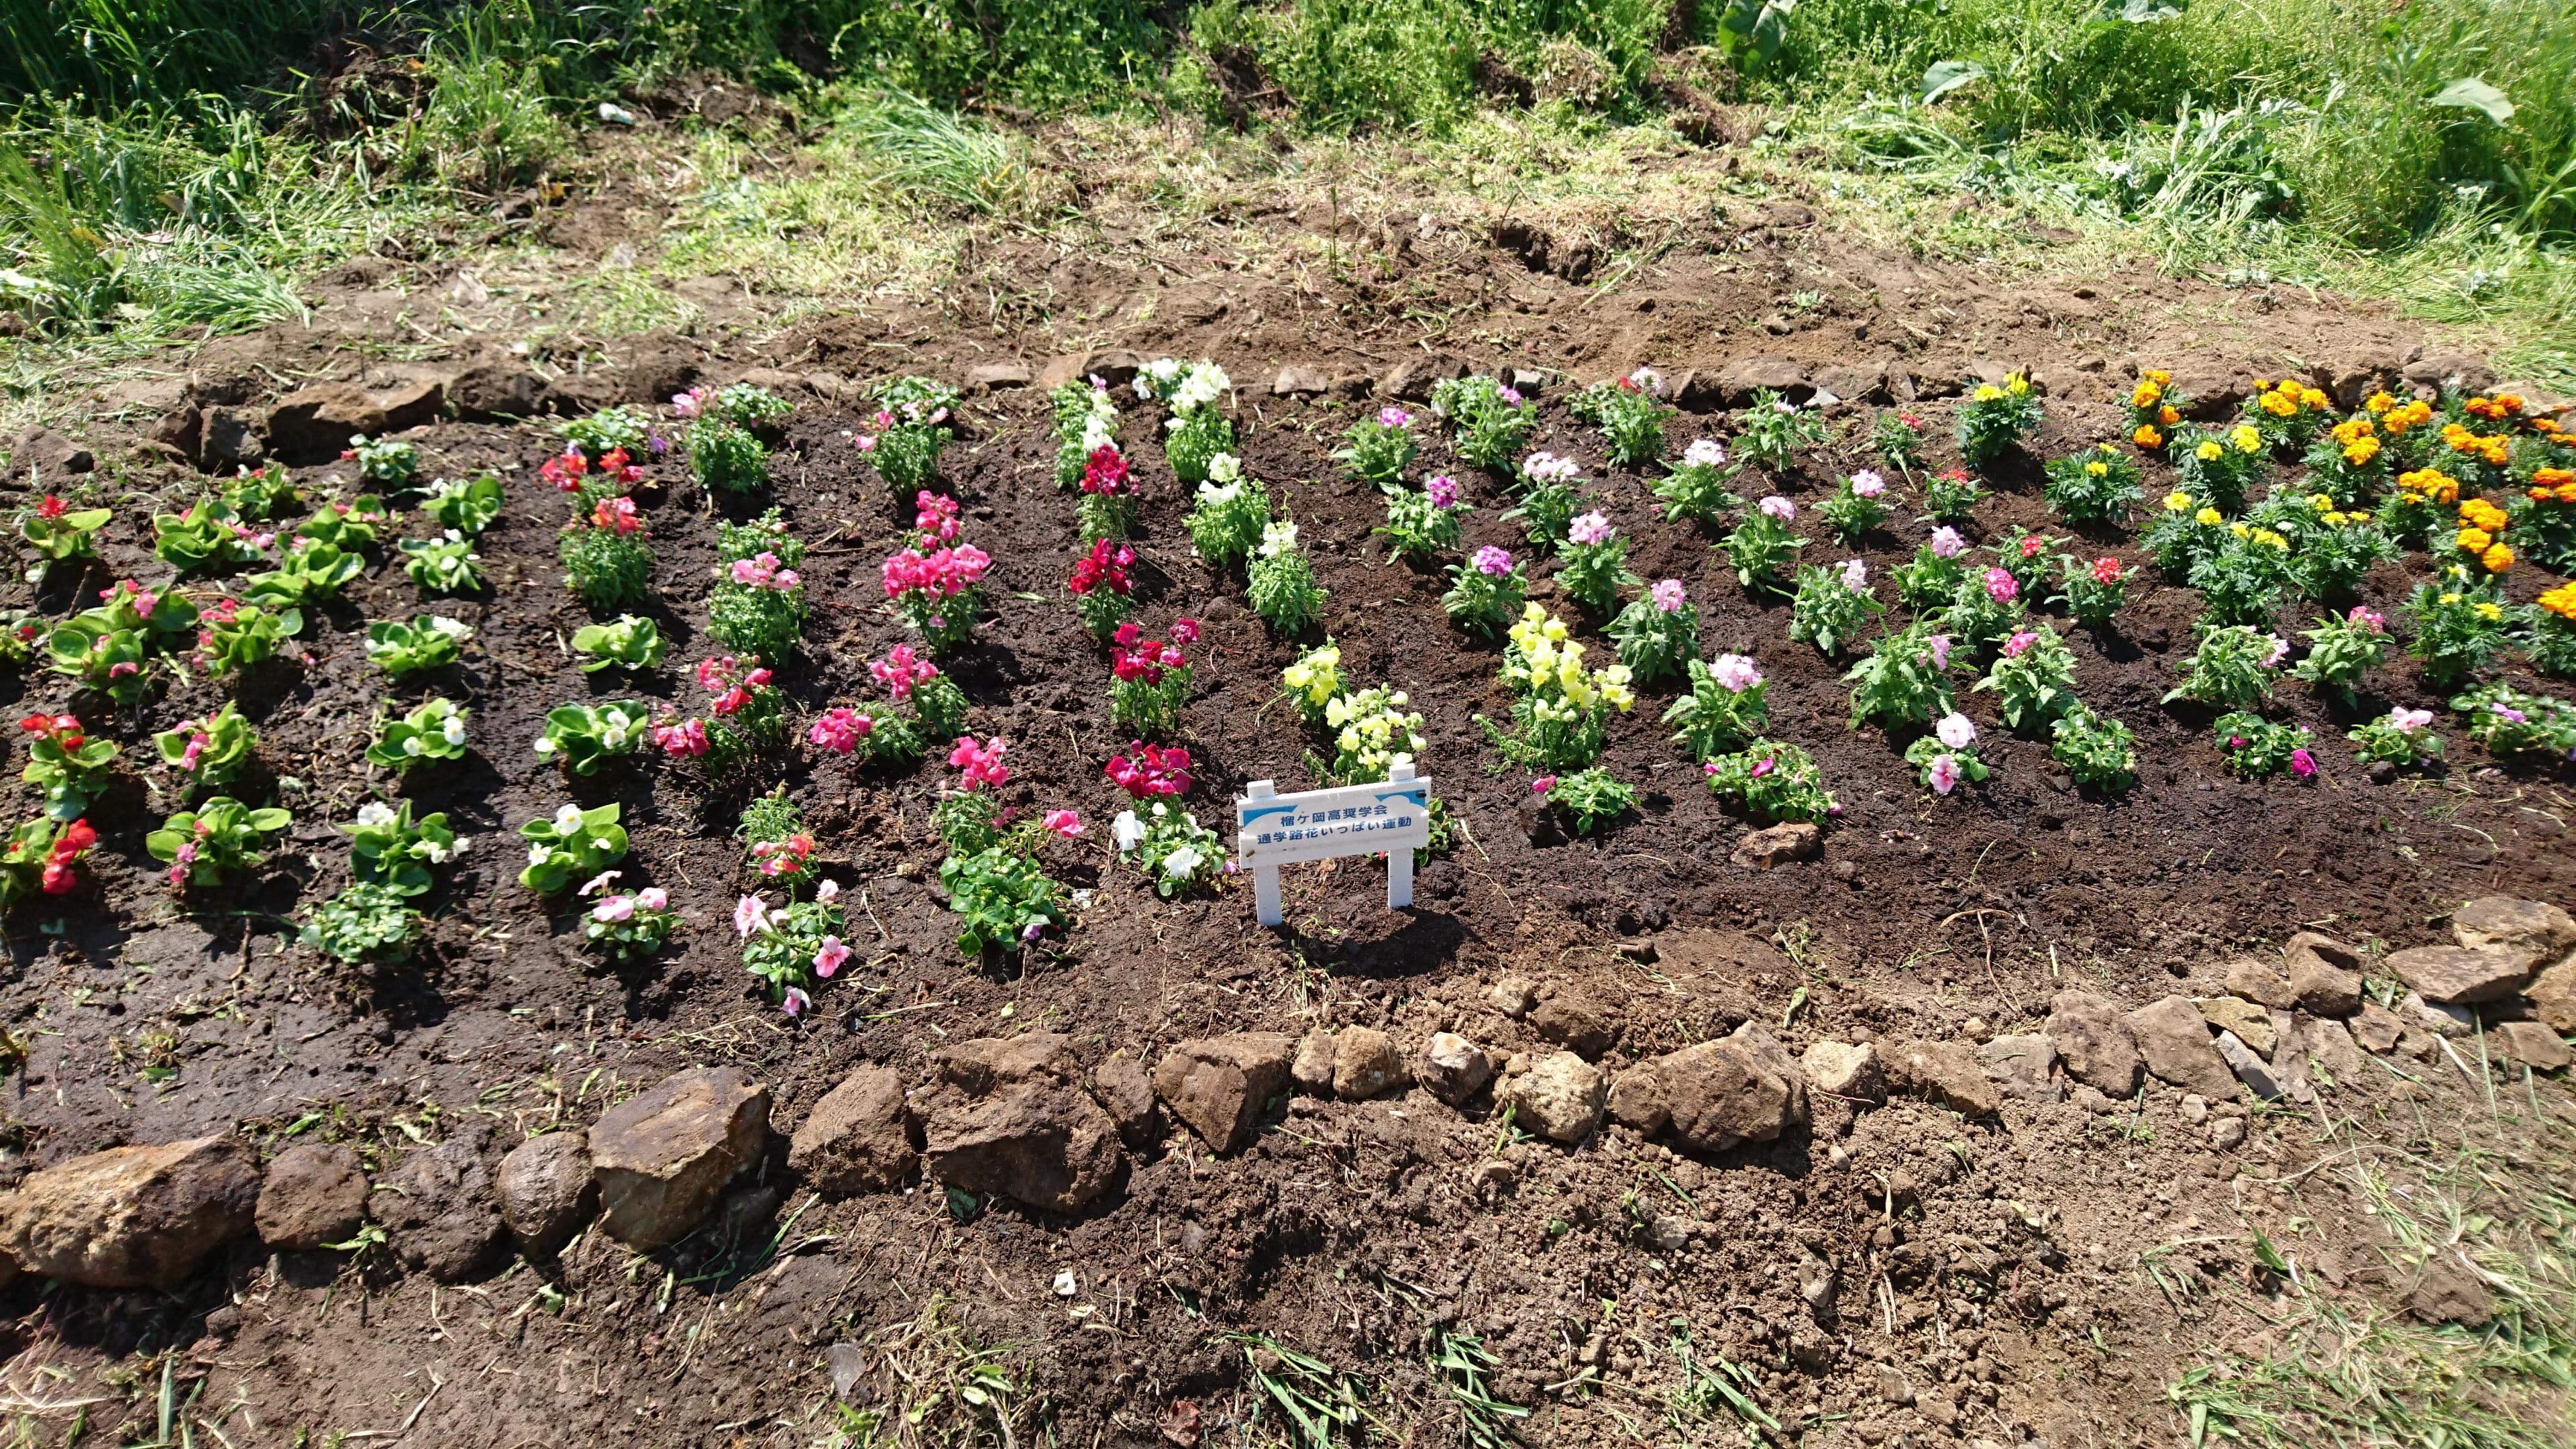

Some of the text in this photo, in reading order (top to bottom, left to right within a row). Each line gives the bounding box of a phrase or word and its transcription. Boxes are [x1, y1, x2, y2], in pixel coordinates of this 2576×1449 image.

[1257, 816, 1412, 844] 通学路花いっぱい運動
